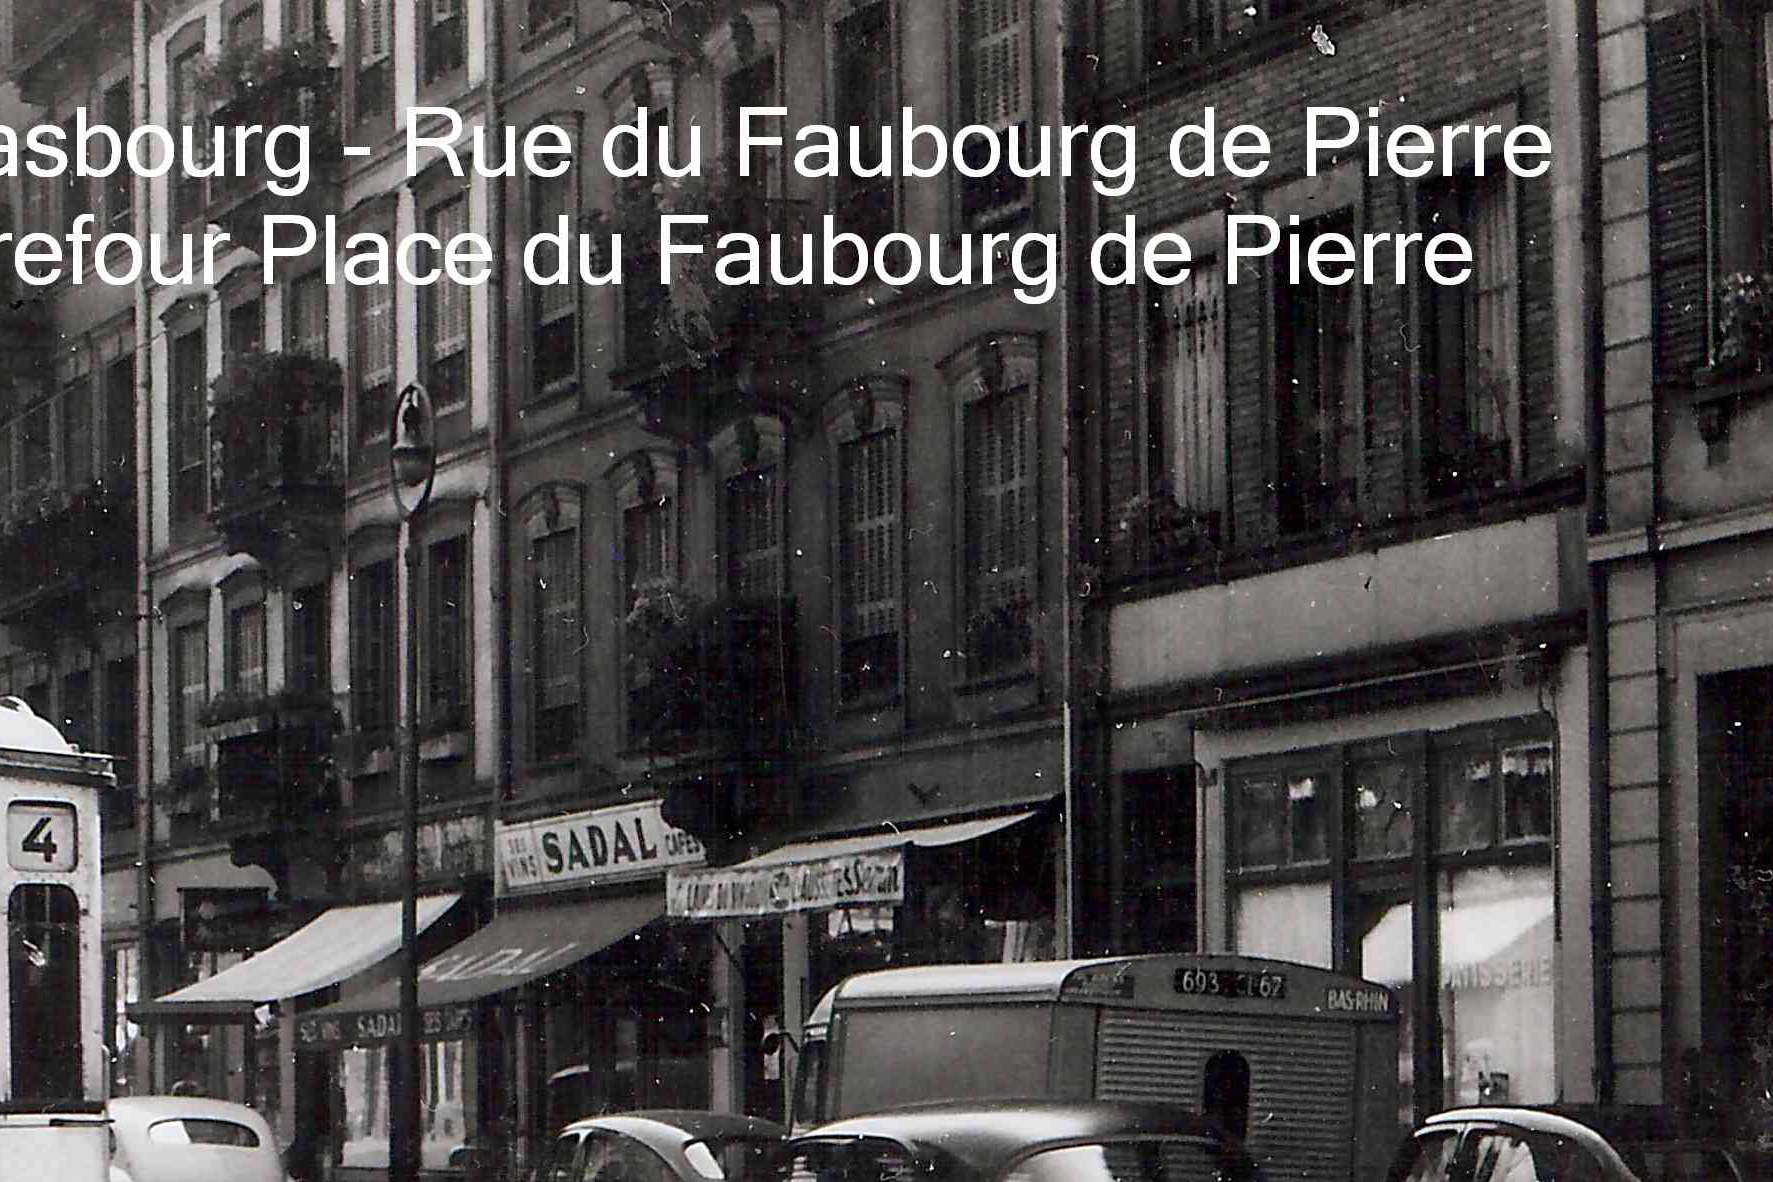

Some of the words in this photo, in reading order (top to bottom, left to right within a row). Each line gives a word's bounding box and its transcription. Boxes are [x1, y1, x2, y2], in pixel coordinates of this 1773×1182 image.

[21, 816, 59, 864] 4
[541, 816, 658, 875] SADAL
[1182, 969, 1220, 994] 693
[1259, 974, 1283, 998] 67
